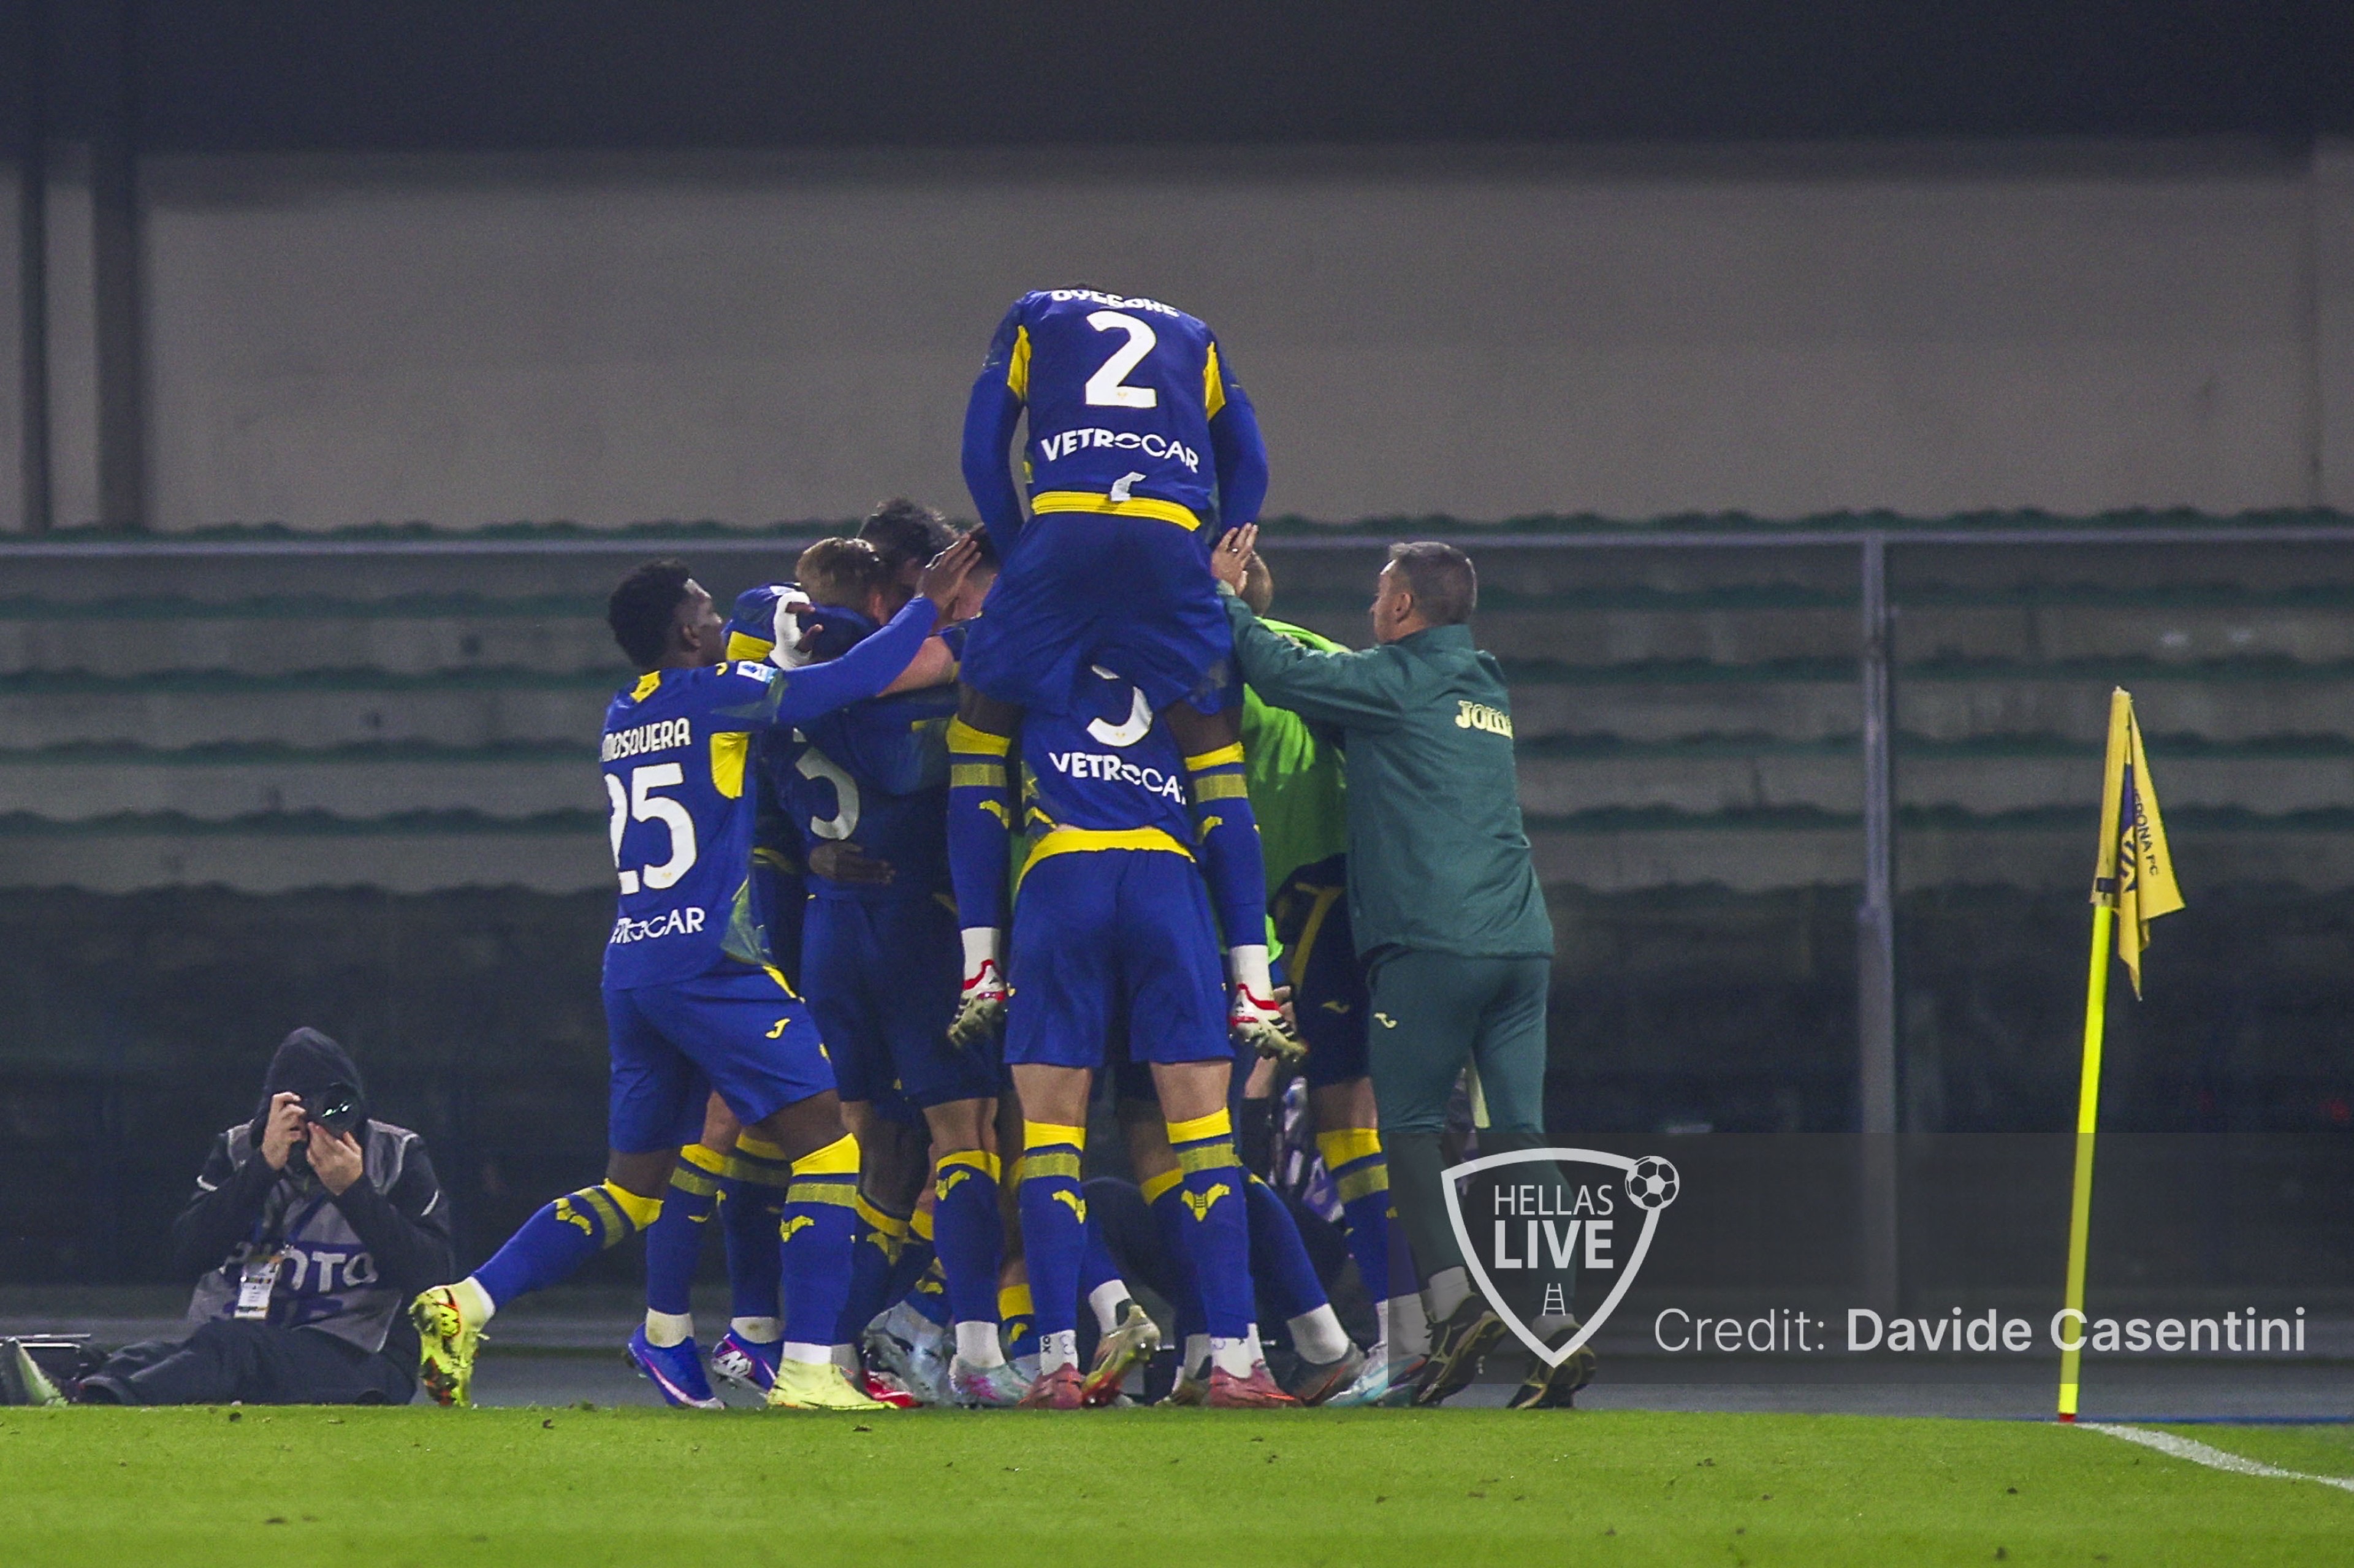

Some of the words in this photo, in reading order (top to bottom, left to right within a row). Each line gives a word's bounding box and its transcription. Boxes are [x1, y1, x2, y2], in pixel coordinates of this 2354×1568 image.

[1086, 310, 1157, 409] 2
[1041, 428, 1199, 473] VETROCAR
[1049, 752, 1187, 805] VETROCA
[603, 763, 697, 894] 25
